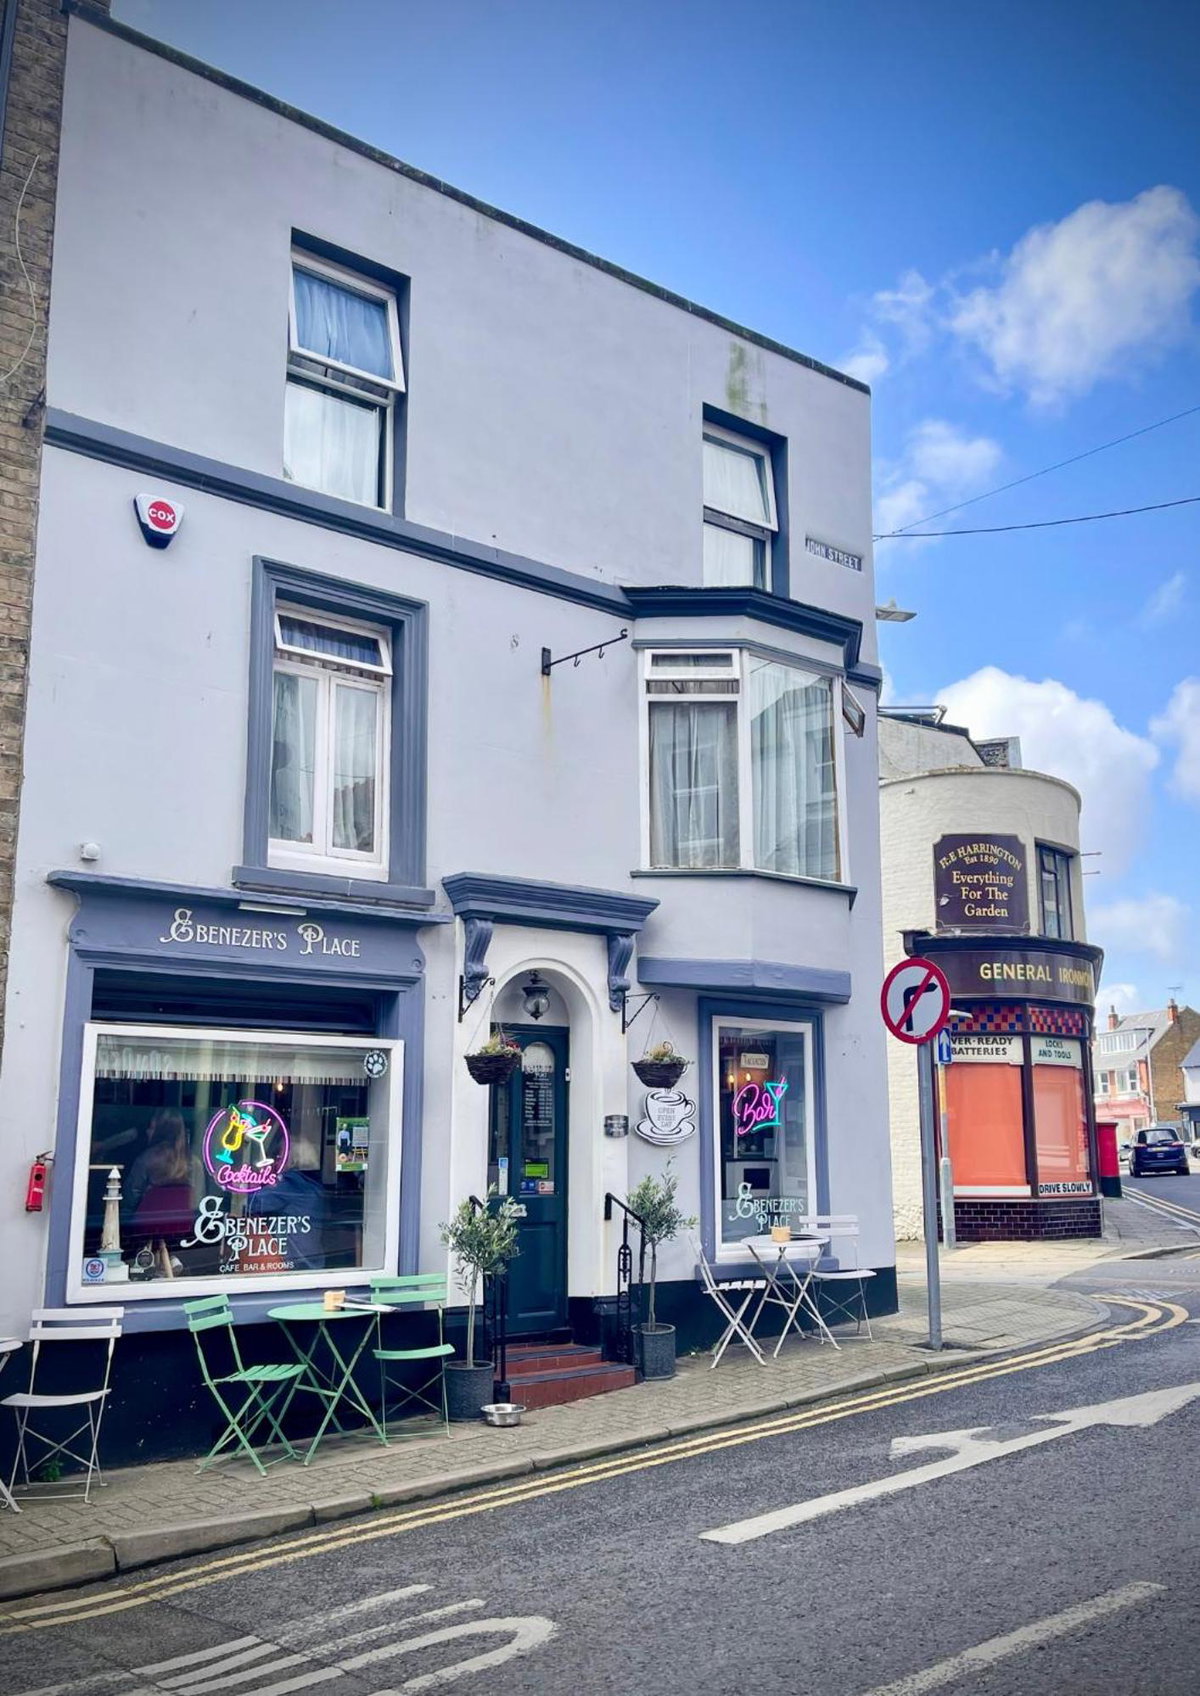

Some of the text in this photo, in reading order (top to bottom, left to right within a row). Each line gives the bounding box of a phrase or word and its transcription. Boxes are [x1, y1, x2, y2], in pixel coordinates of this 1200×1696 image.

[149, 508, 175, 523] COX
[806, 539, 859, 569] JOHN STREET
[957, 843, 1022, 871] HARRINGTON
[980, 854, 999, 865] 1890
[952, 871, 1014, 888] Everything
[961, 886, 1009, 900] For The
[964, 903, 1009, 917] Garden
[160, 908, 361, 957] EBENEZER'S PLACE
[980, 962, 1053, 981] GENERAL
[951, 1037, 1013, 1045] VER-READY
[1045, 1039, 1063, 1048] LOCKS
[951, 1047, 1007, 1056] BATTERIES
[1038, 1049, 1072, 1059] AND TOOLS
[734, 1083, 776, 1135] Bar
[217, 1164, 277, 1185] Cocktails
[1039, 1181, 1091, 1194] DRIVE SLOWLY
[728, 1182, 805, 1221] EBENEZER'S
[180, 1195, 312, 1248] EBENEZER'S
[227, 1235, 287, 1262] PLACE
[243, 1263, 259, 1272] BAR
[267, 1261, 295, 1270] ROOMS
